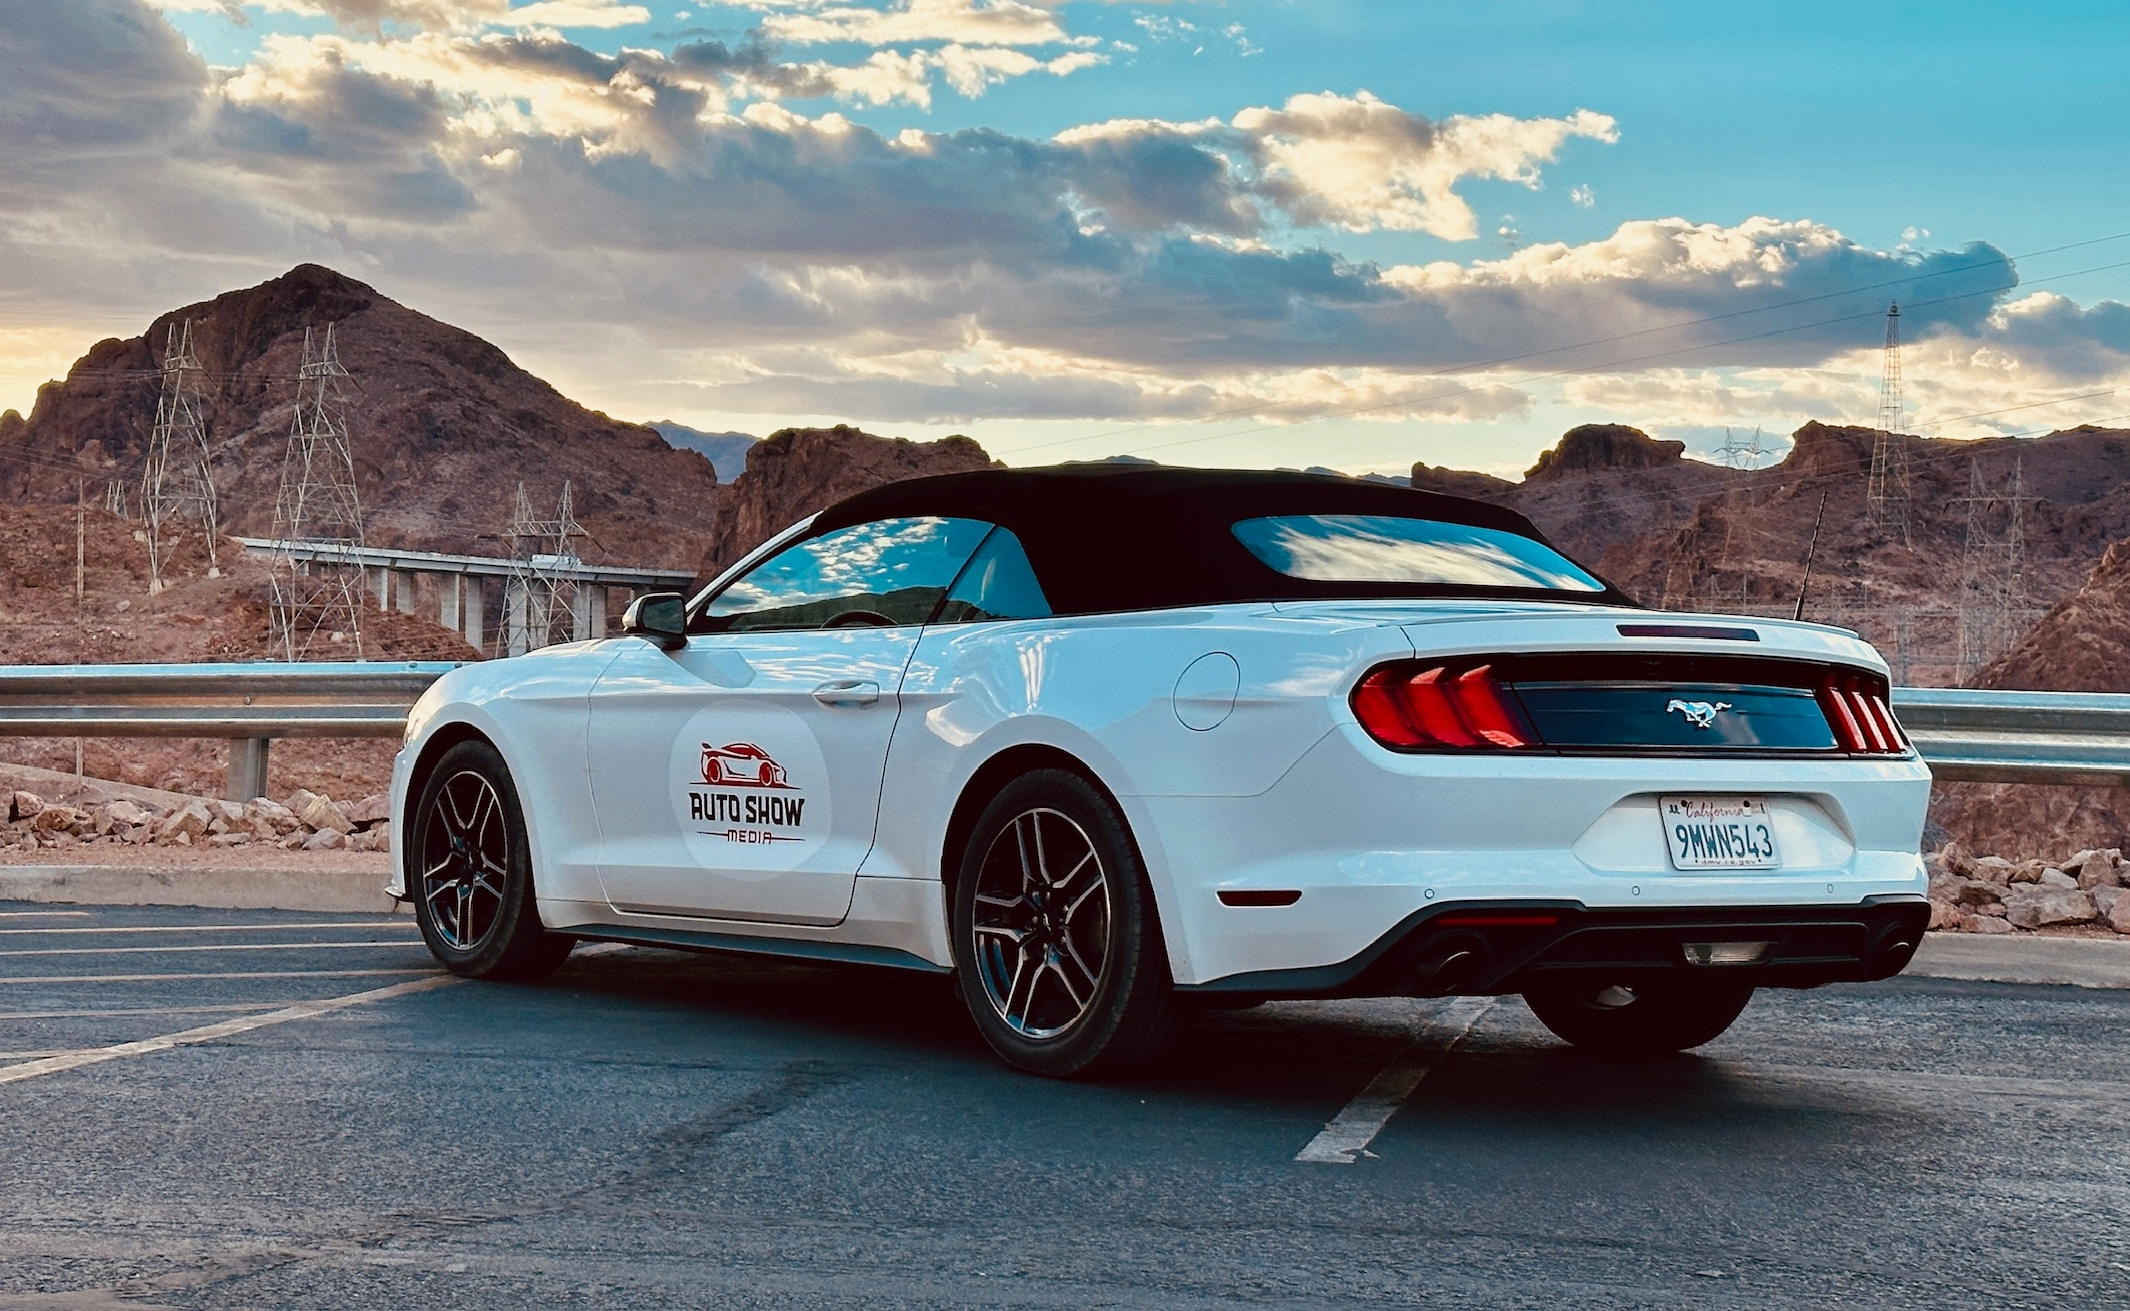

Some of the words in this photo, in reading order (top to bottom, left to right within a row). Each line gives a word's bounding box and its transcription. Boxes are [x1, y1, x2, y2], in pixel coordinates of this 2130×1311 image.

[688, 793, 741, 822] AUTO
[745, 796, 805, 826] SHOW
[1686, 802, 1745, 823] California
[728, 829, 772, 845] MEDIA
[1676, 824, 1773, 859] 9MWN543
